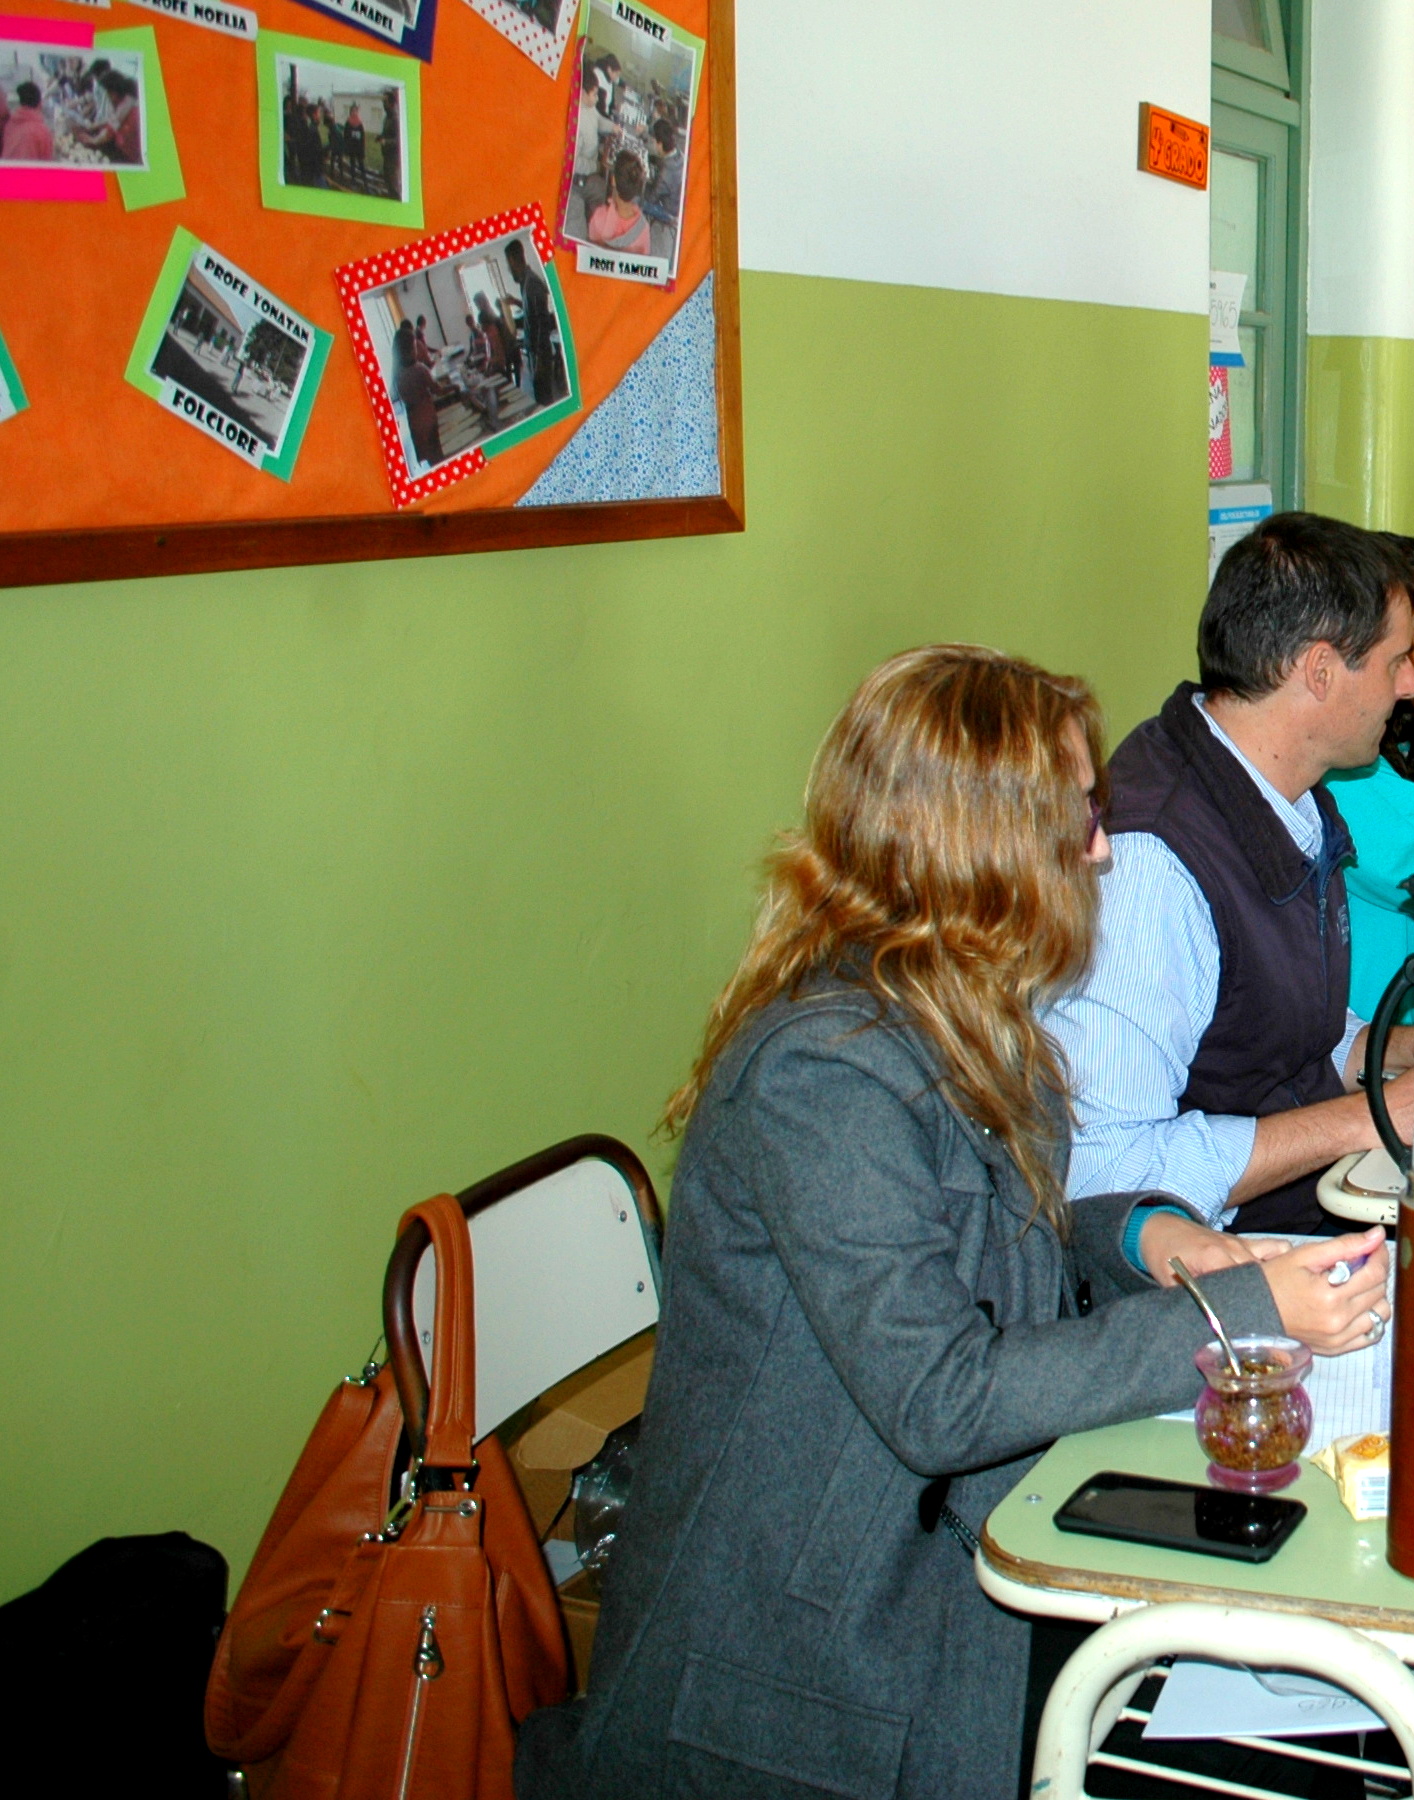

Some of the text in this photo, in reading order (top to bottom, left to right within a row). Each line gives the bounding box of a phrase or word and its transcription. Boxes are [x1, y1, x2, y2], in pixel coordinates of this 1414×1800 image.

[193, 4, 248, 32] NOELIA
[351, 1, 394, 33] ANABEL
[617, 2, 667, 42] AJEDREZ
[589, 256, 659, 279] PROFE SAMUEL
[204, 255, 309, 343] PROFE YONATAN
[173, 387, 259, 457] FOLCLORE
